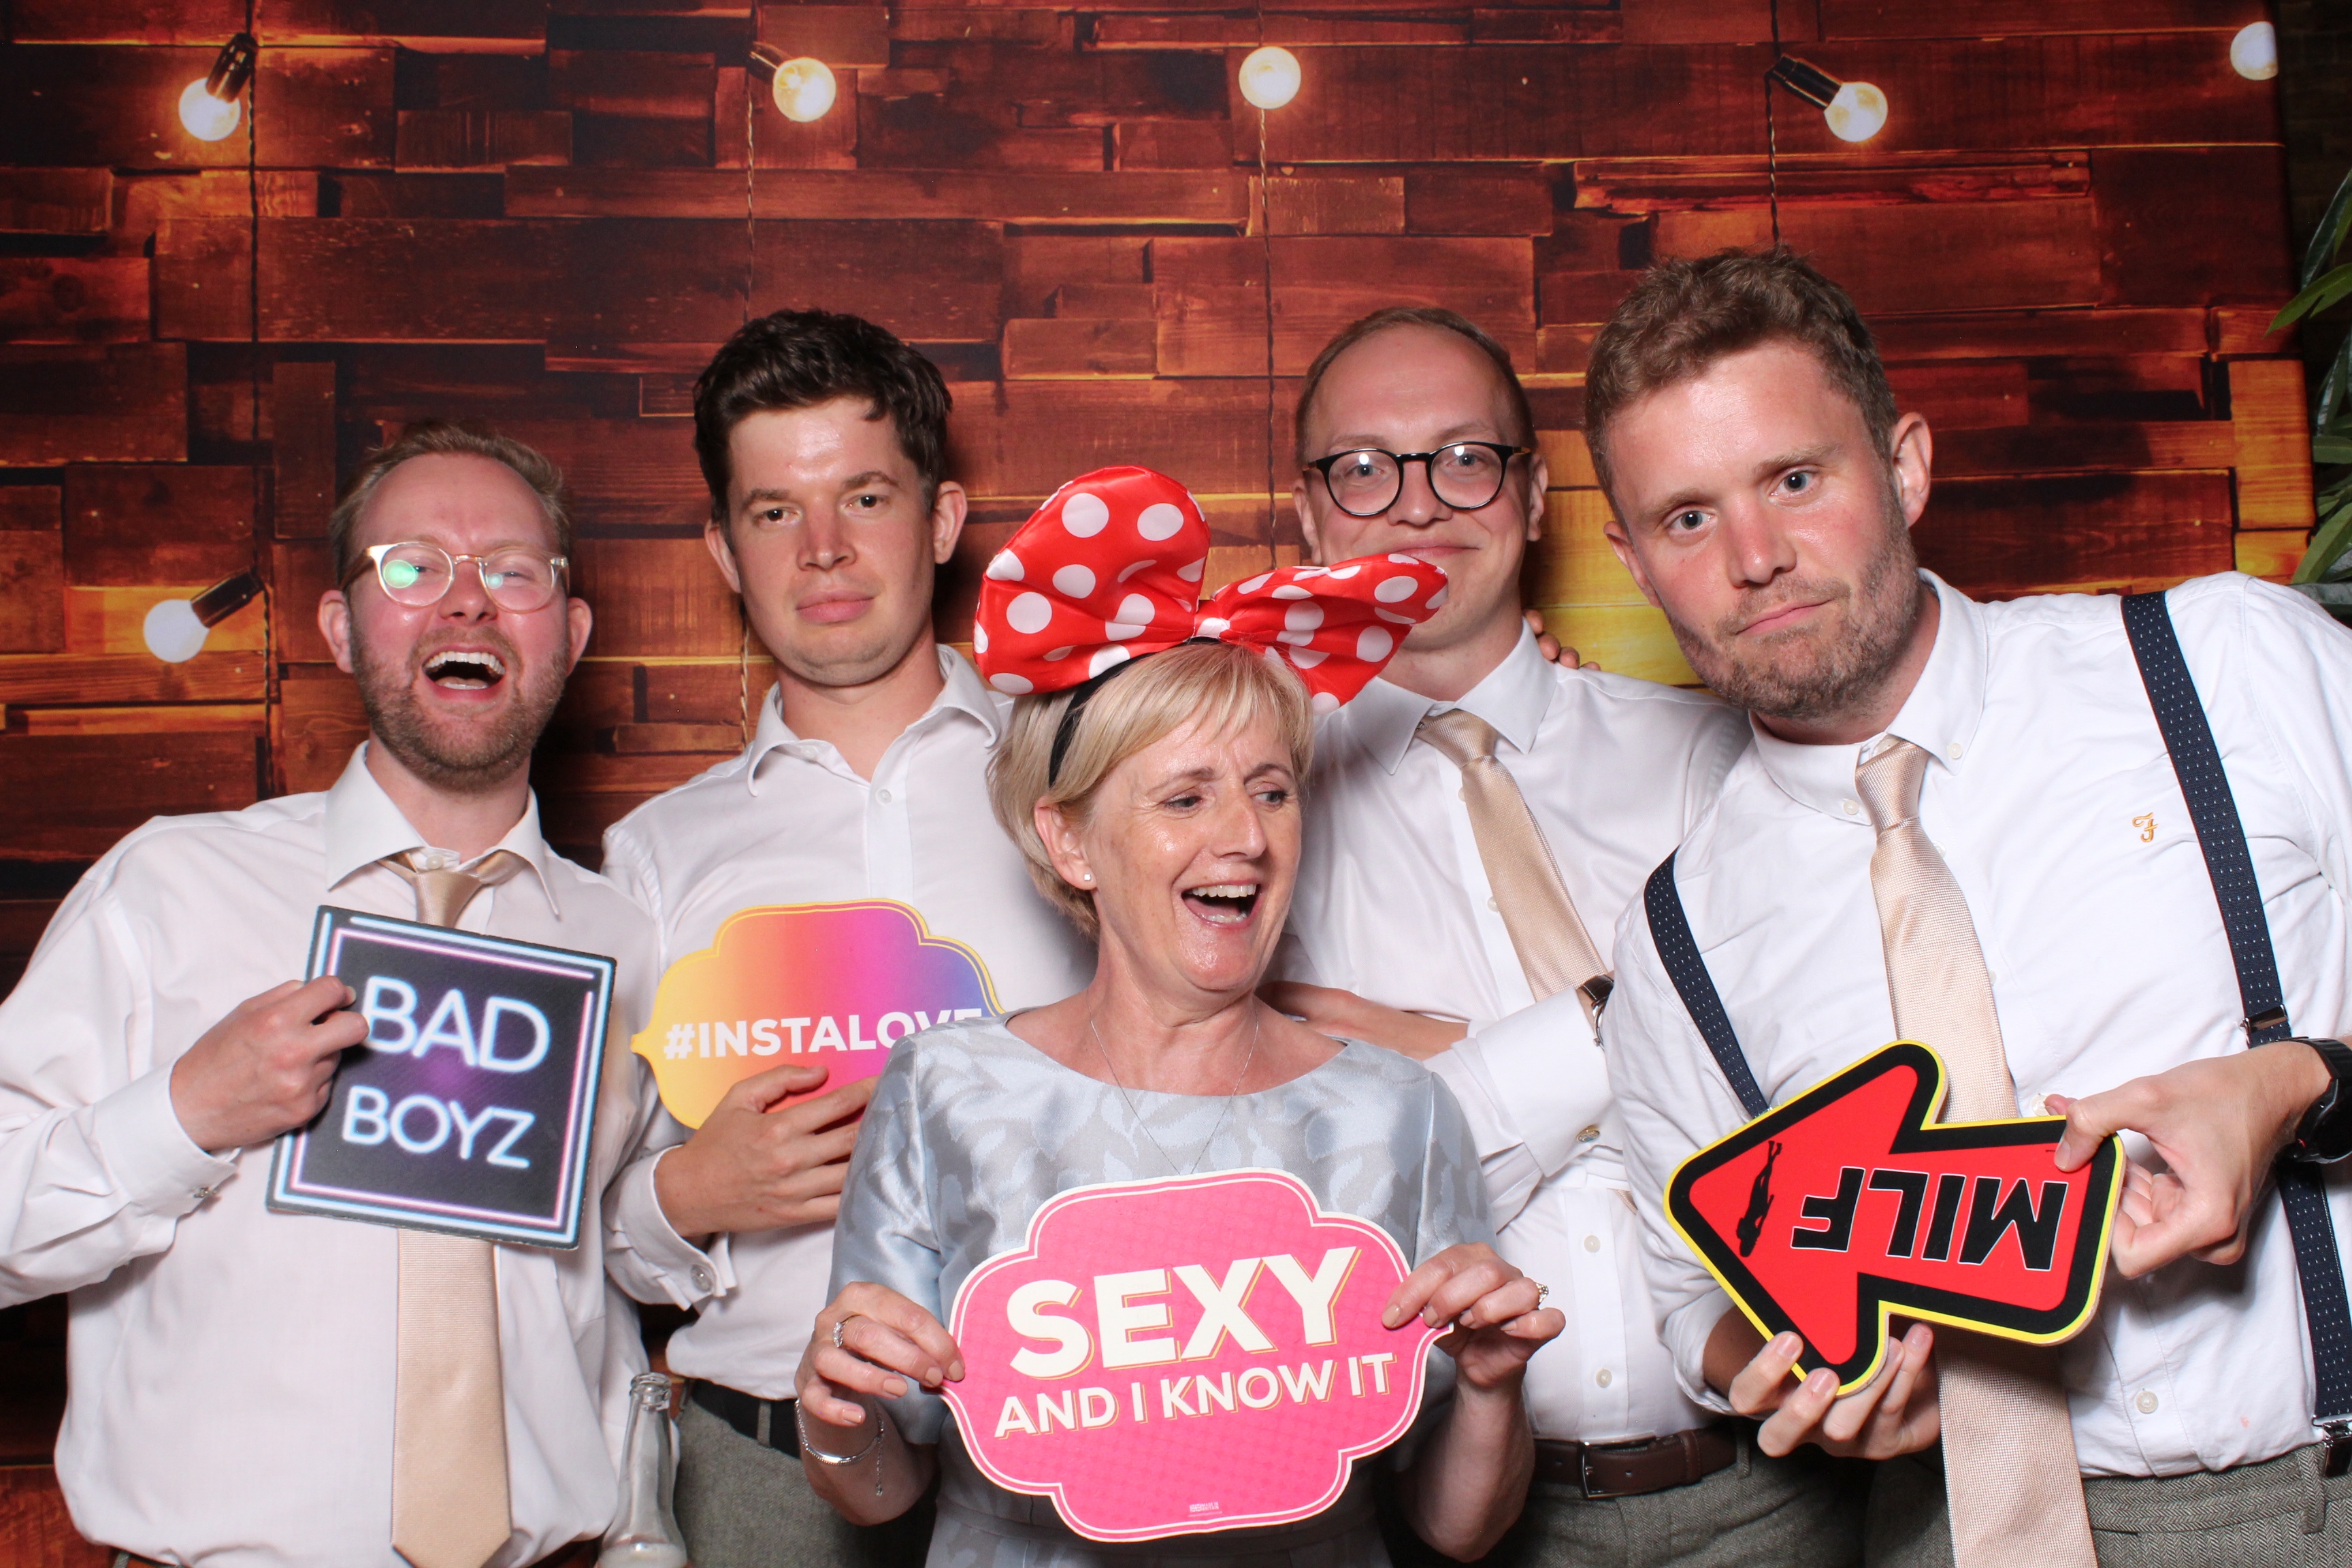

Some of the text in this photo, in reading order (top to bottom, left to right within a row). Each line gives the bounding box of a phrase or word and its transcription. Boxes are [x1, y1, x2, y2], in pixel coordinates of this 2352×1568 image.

[363, 976, 551, 1073] BAD
[341, 1085, 536, 1169] BOYZ
[1791, 1166, 2069, 1271] MILF
[1006, 1246, 1361, 1380] SEXY
[994, 1352, 1397, 1439] AND I KNOW IT
